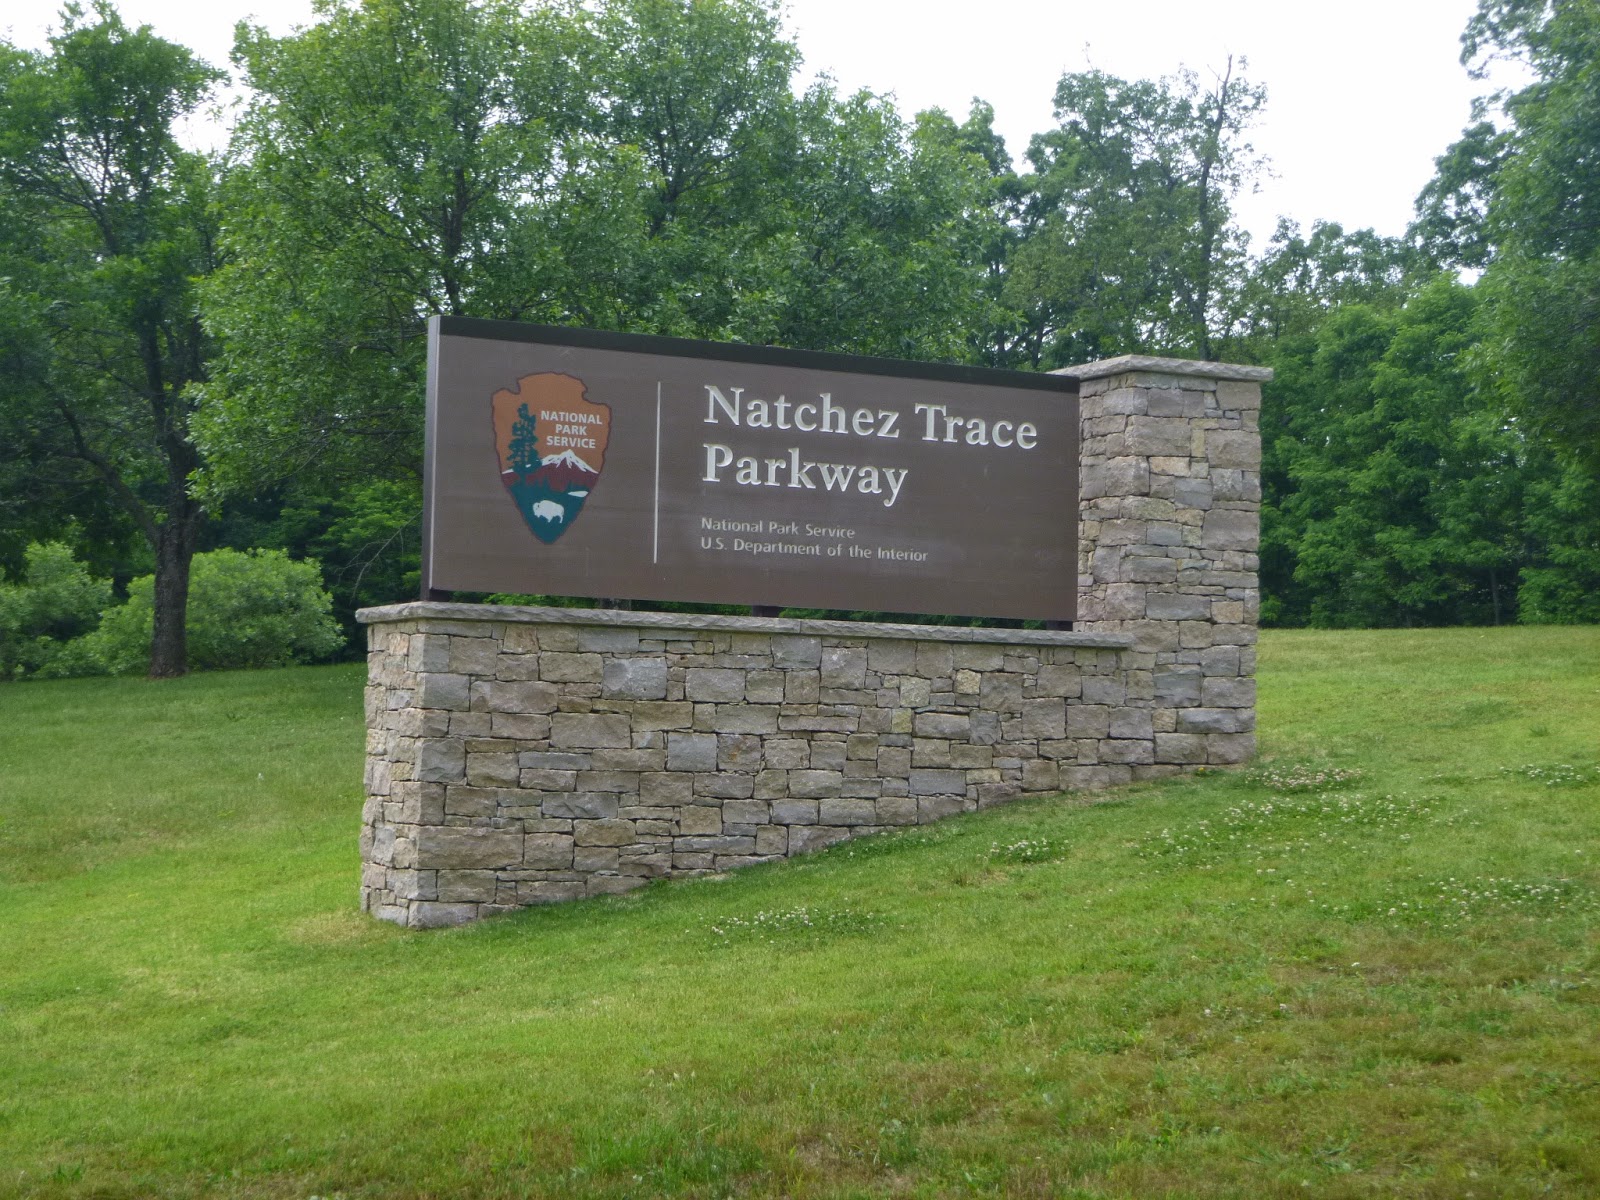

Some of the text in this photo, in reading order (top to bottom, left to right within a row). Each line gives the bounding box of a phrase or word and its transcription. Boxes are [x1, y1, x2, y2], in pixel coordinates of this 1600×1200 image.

[540, 410, 603, 425] NATIONAL
[703, 384, 1038, 449] Natchez Trace
[555, 424, 587, 436] PARK
[546, 436, 596, 449] SERVICE
[702, 443, 909, 507] Parkway
[701, 517, 856, 539] National Park Service
[701, 536, 928, 562] U.S. Department of the Interior
